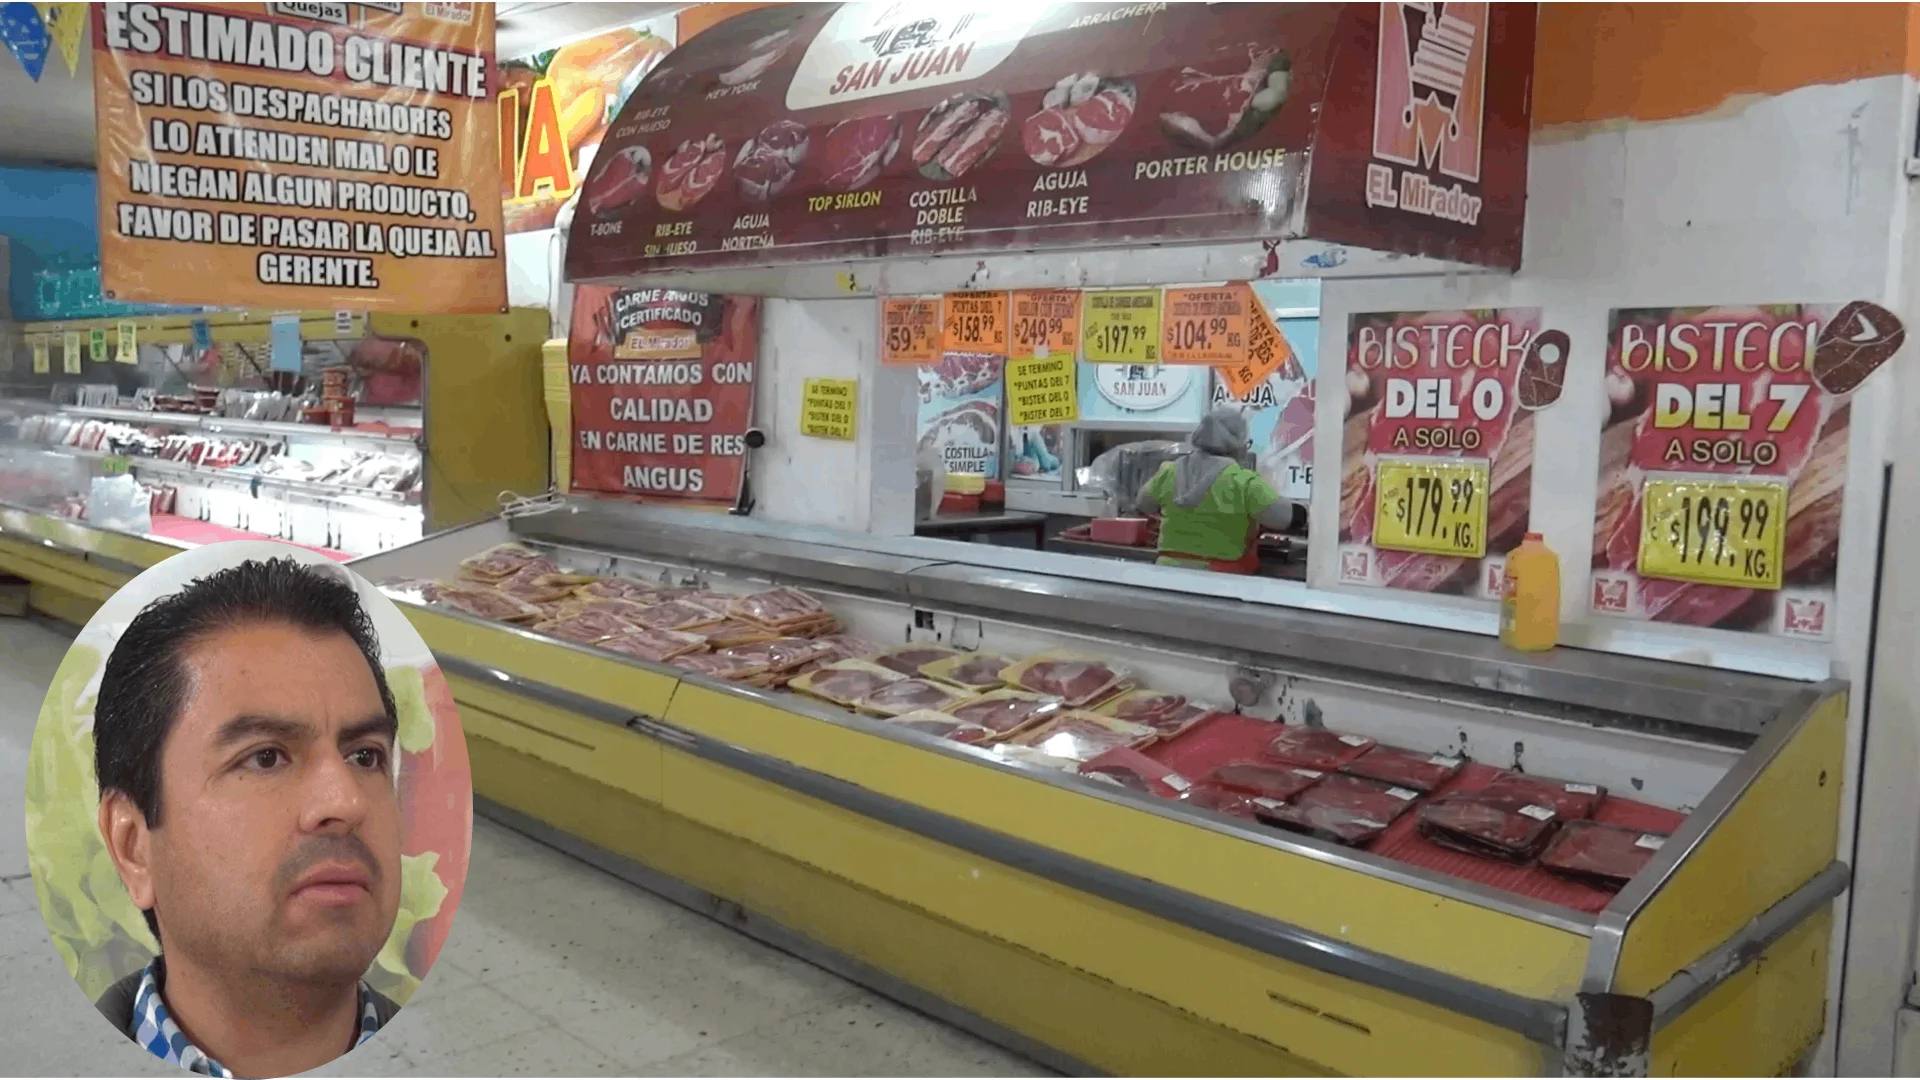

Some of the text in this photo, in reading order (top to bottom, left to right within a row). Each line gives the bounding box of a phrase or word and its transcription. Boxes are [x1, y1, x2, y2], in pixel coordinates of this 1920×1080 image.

[1068, 2, 1168, 29] ARRACHERA
[105, 2, 487, 98] ESTIMADO CLIENTE
[829, 41, 976, 95] SAN JUAN
[131, 70, 452, 140] SI LOS DESPACHADORES
[151, 117, 439, 179] LO ATIENDEN MAL O LE
[1134, 148, 1286, 180] PORTER HOUSE
[129, 159, 477, 223] NIEGAN ALGUN PRODUCTO,
[1032, 170, 1088, 192] AGUJA
[808, 190, 882, 212] TOP SIRLON
[909, 185, 977, 208] COSTILLA
[1026, 196, 1089, 218] RIB-EYE
[1400, 171, 1482, 226] Mirador
[590, 221, 623, 236] T-BONE
[733, 214, 770, 230] AGUJA
[916, 206, 964, 226] DOBLE
[117, 202, 497, 259] FAVOR DE PASAR LA QUEJA AL
[655, 221, 693, 237] RIB-EYE
[256, 251, 380, 288] GERENTE.
[616, 289, 661, 312] CARNE
[621, 307, 702, 329] CERTIFICADO
[570, 362, 753, 384] YA CONTAMOS CON
[1113, 381, 1167, 396] SAN JUAN
[1385, 377, 1459, 420] DEL
[610, 397, 714, 423] CALIDAD
[1654, 382, 1810, 432] DEL 7
[579, 430, 745, 455] EN CARNE DE RES
[1393, 427, 1481, 449] A SOLO
[945, 446, 988, 459] COSTILLA
[1664, 438, 1777, 466] A SOLO
[623, 465, 704, 492] ANGUS
[949, 461, 985, 473] SIMPLE
